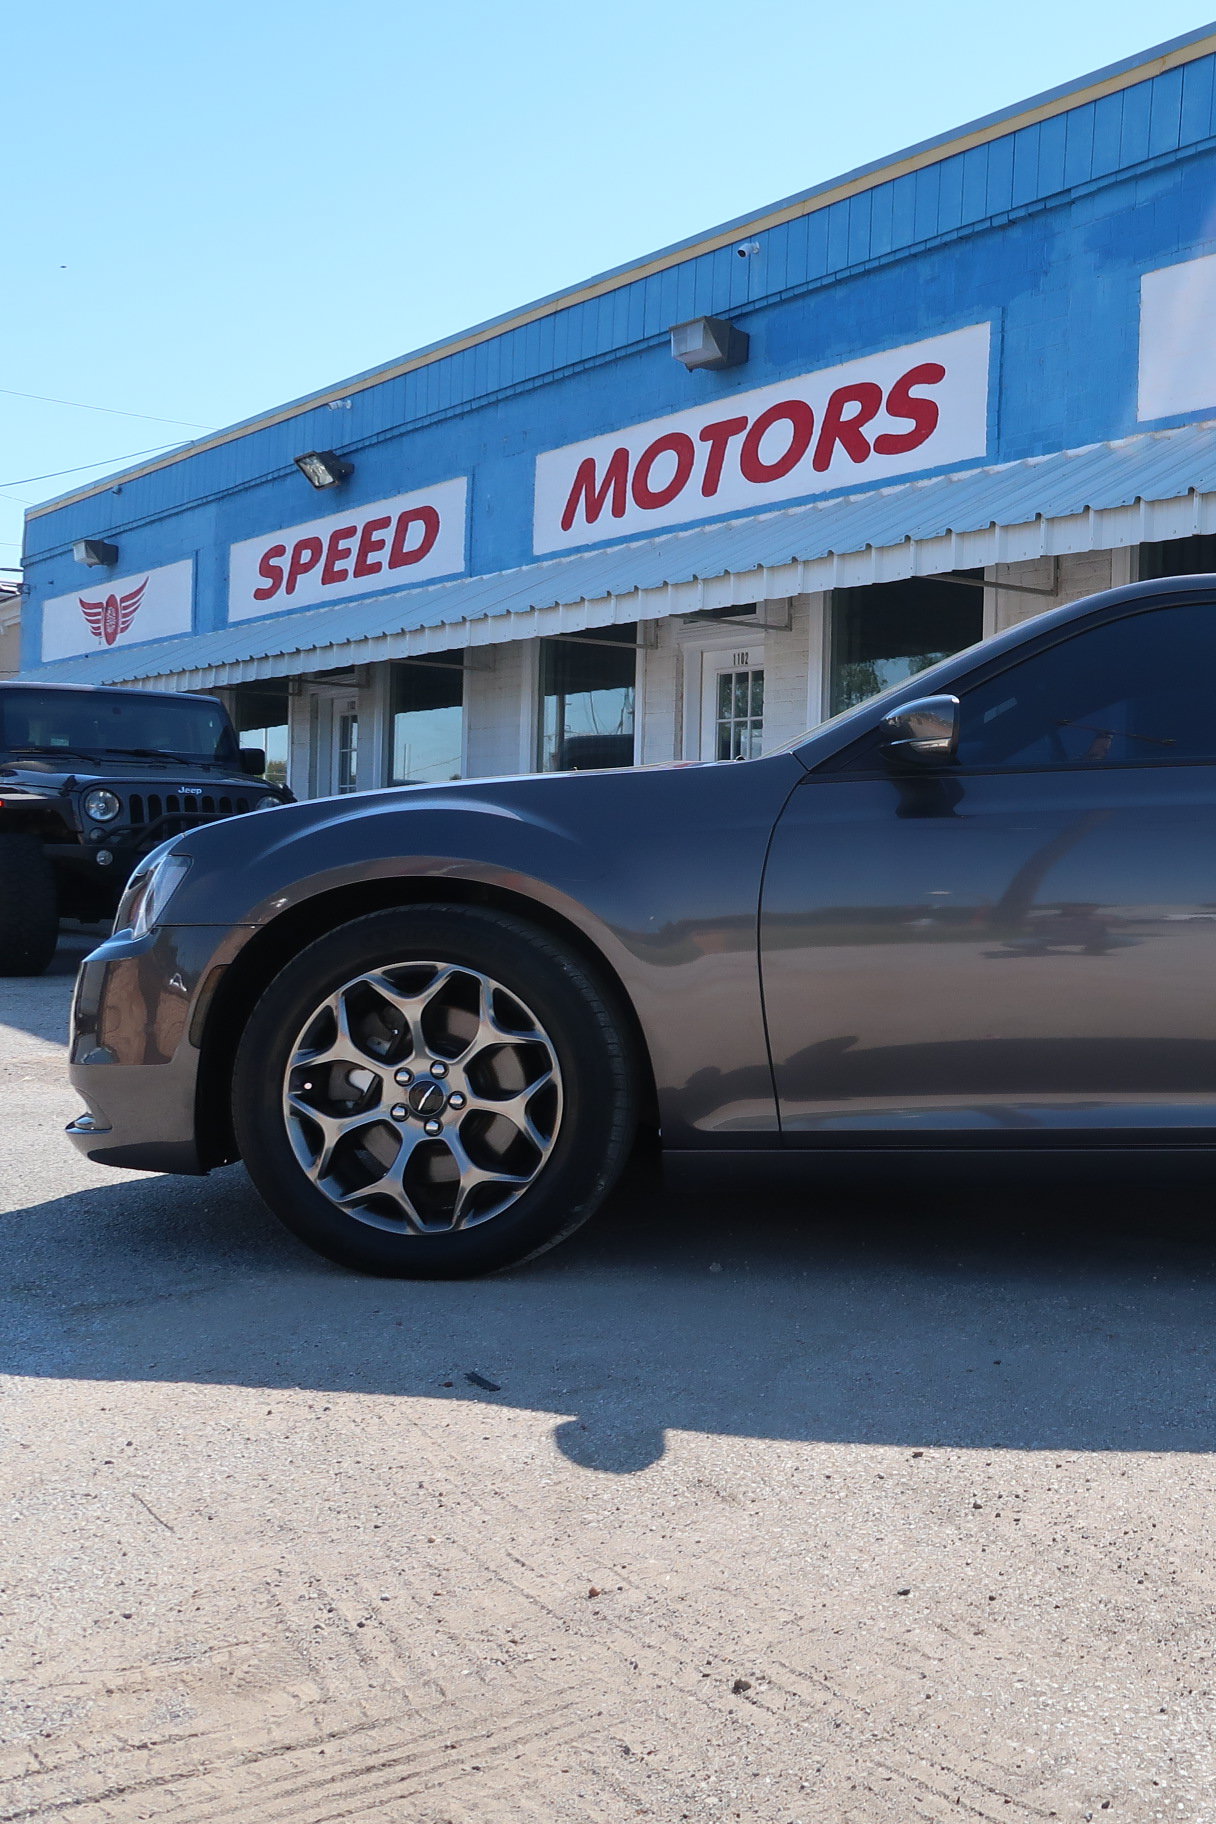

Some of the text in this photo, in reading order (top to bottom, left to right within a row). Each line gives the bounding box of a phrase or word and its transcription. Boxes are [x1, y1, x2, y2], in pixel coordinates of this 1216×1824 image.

[561, 362, 944, 530] MOTORS
[253, 504, 441, 602] SPEED
[178, 786, 203, 796] Jeep
